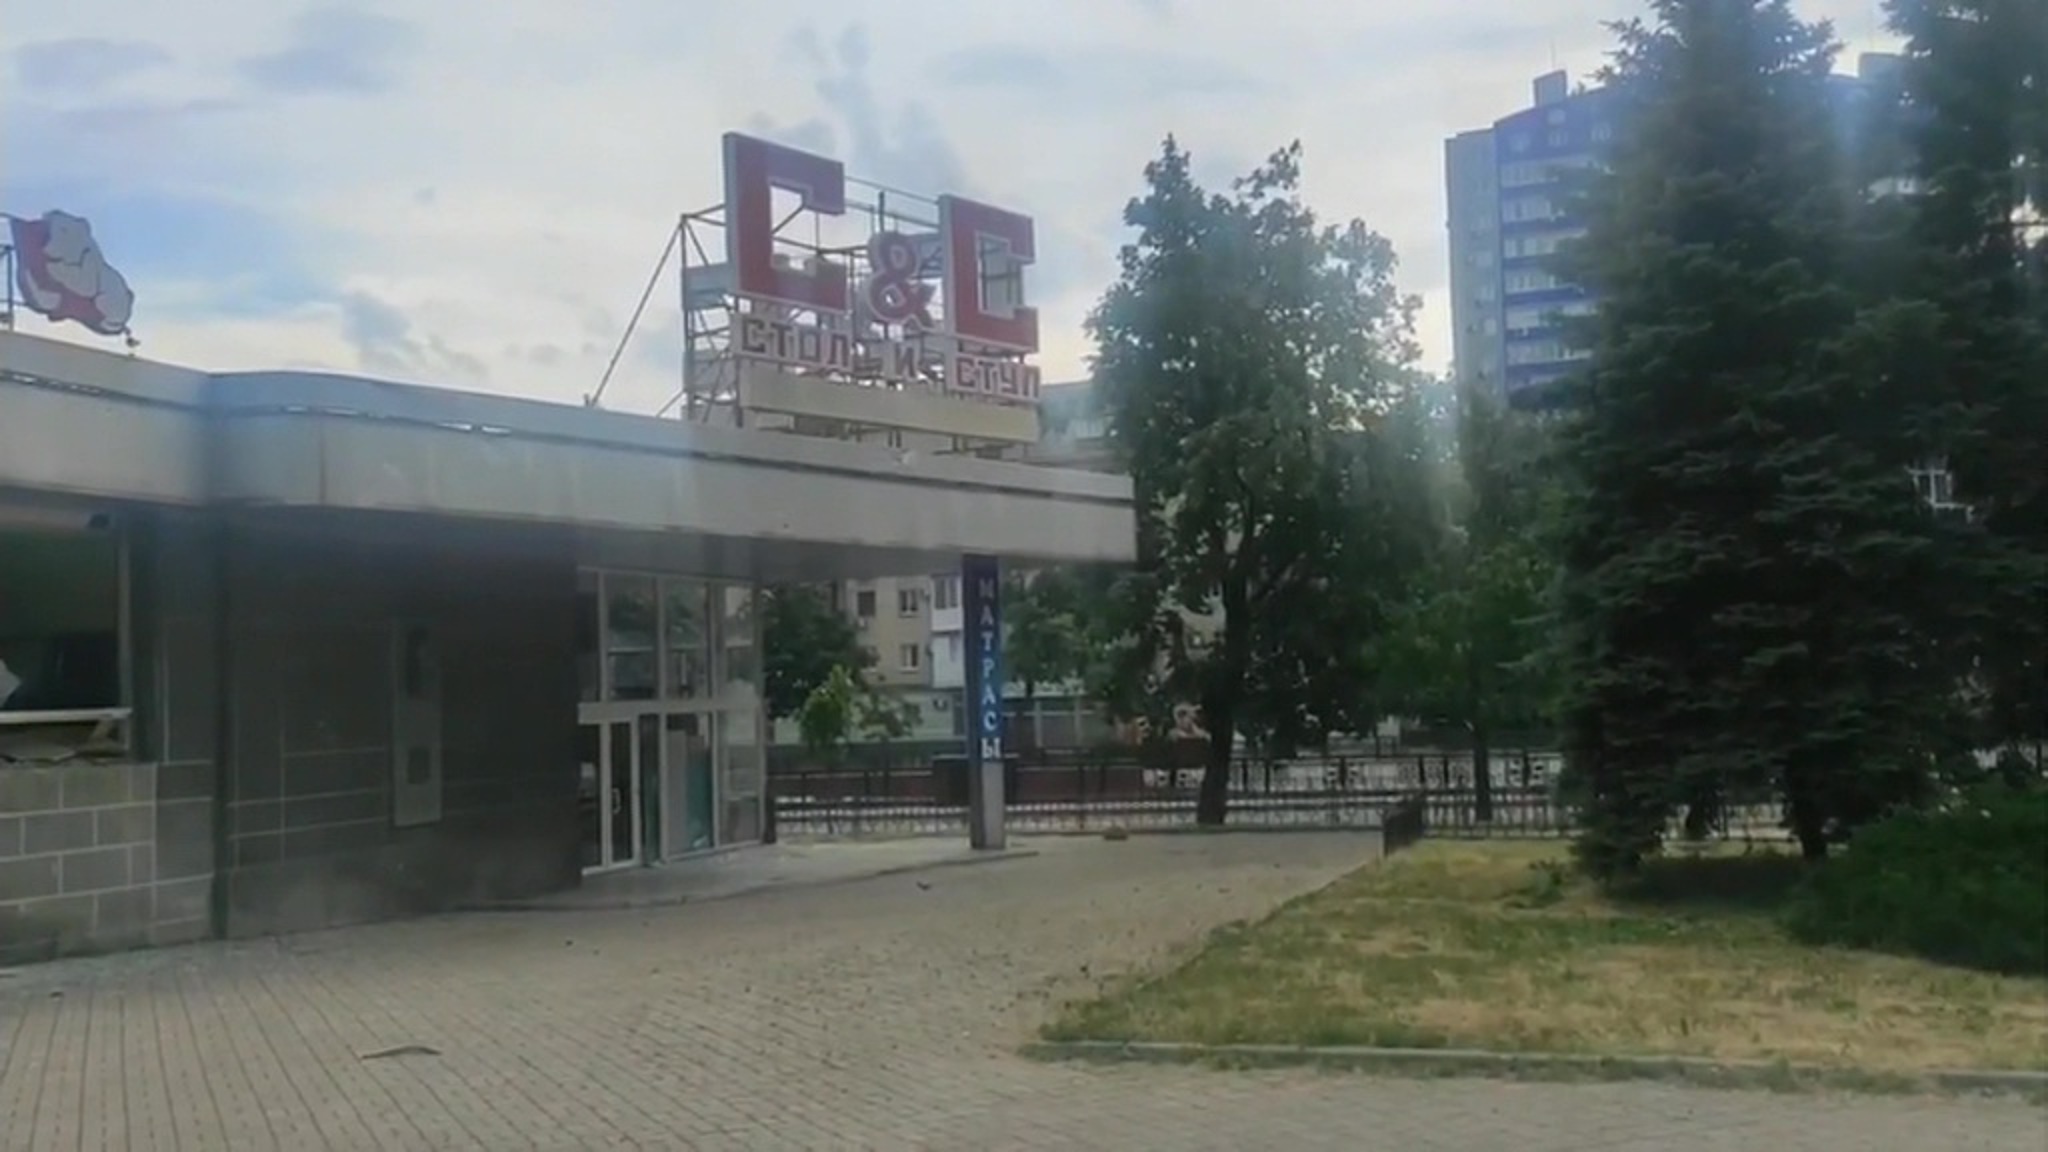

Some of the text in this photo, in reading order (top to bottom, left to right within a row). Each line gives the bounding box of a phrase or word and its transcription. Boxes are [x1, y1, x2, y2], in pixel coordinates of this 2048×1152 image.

[739, 316, 1041, 401] СТОЛ И СТУЛ
[979, 577, 1001, 760] МАТРАСЫ
